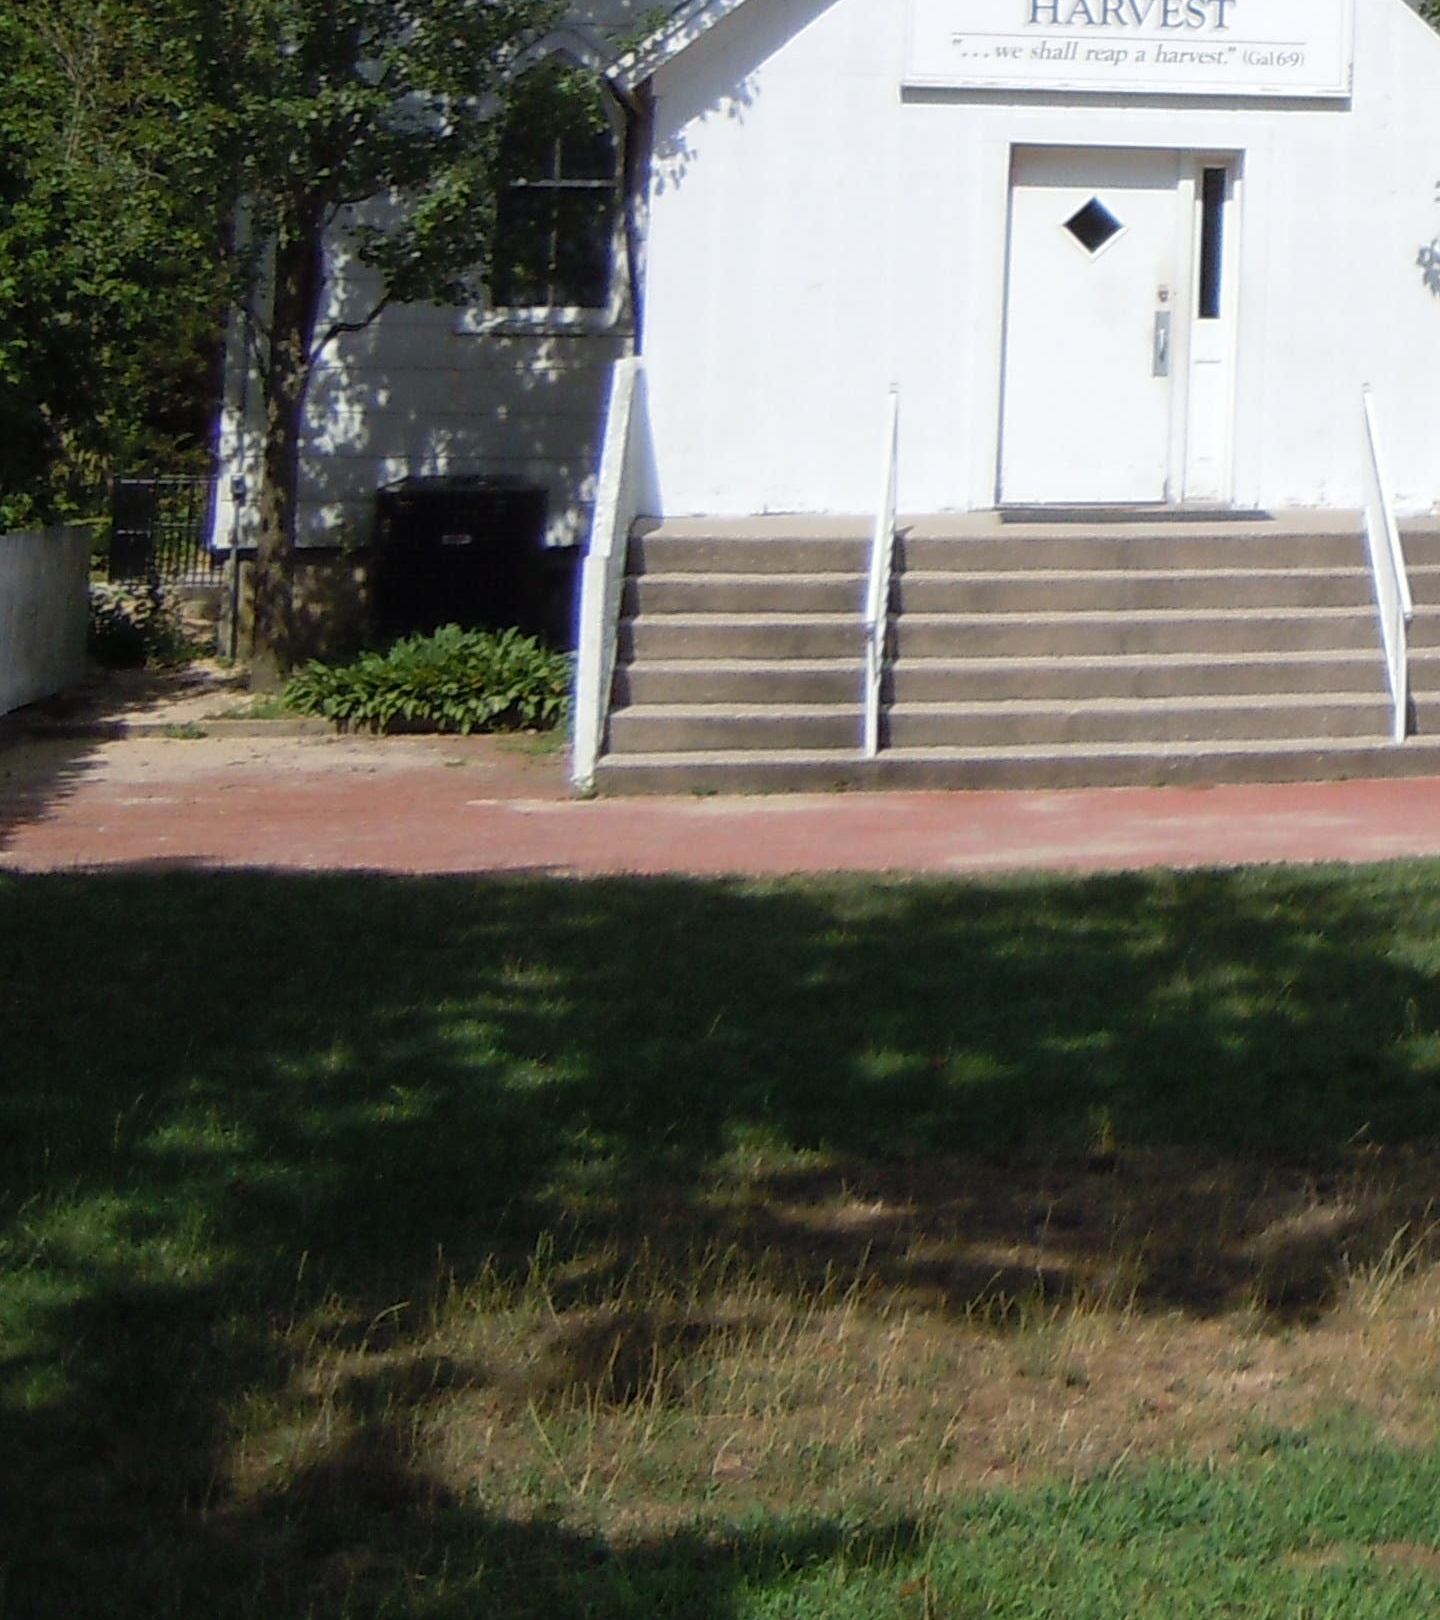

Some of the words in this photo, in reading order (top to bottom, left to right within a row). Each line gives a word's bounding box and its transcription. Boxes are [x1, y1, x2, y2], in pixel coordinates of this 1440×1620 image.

[1030, 40, 1079, 61] shall
[1086, 46, 1128, 67] reap
[1134, 49, 1147, 63] a
